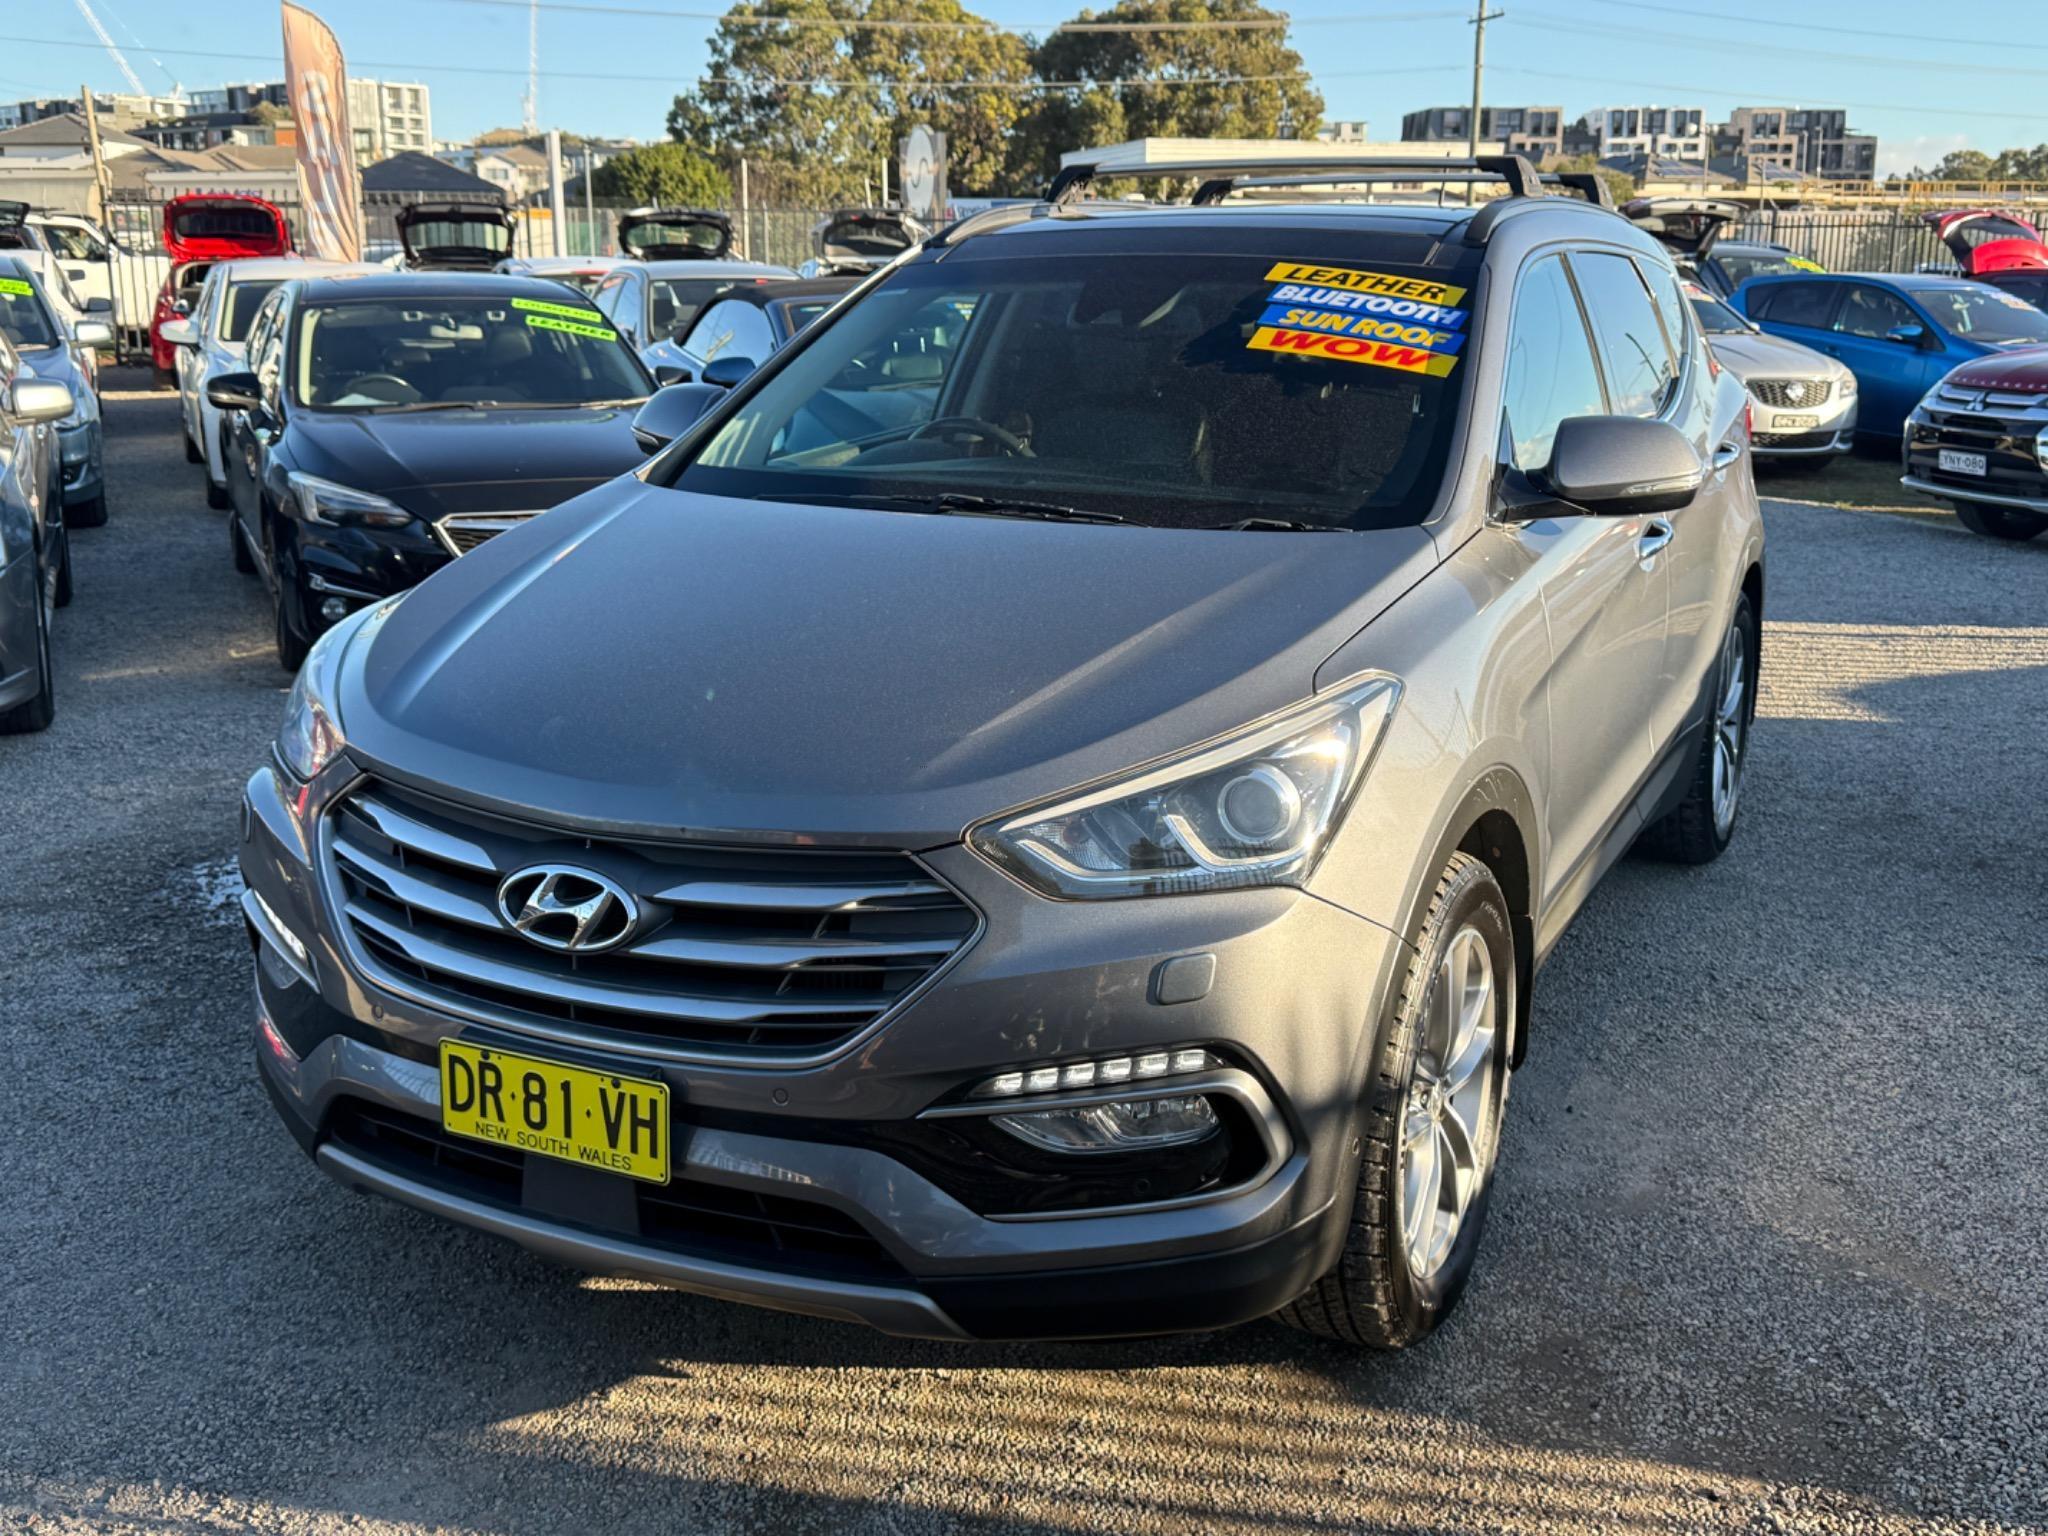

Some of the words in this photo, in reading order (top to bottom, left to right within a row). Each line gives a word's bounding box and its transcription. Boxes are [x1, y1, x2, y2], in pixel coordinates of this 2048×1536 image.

[1283, 267, 1447, 299] LEATHER
[1272, 285, 1463, 325] BLUETOOTH
[1278, 309, 1354, 332] SUN
[1349, 319, 1454, 347] ROOF
[1269, 330, 1441, 367] WOW
[475, 1121, 509, 1140] NEW
[517, 1131, 570, 1156] SOUTH
[578, 1145, 632, 1171] WALES
